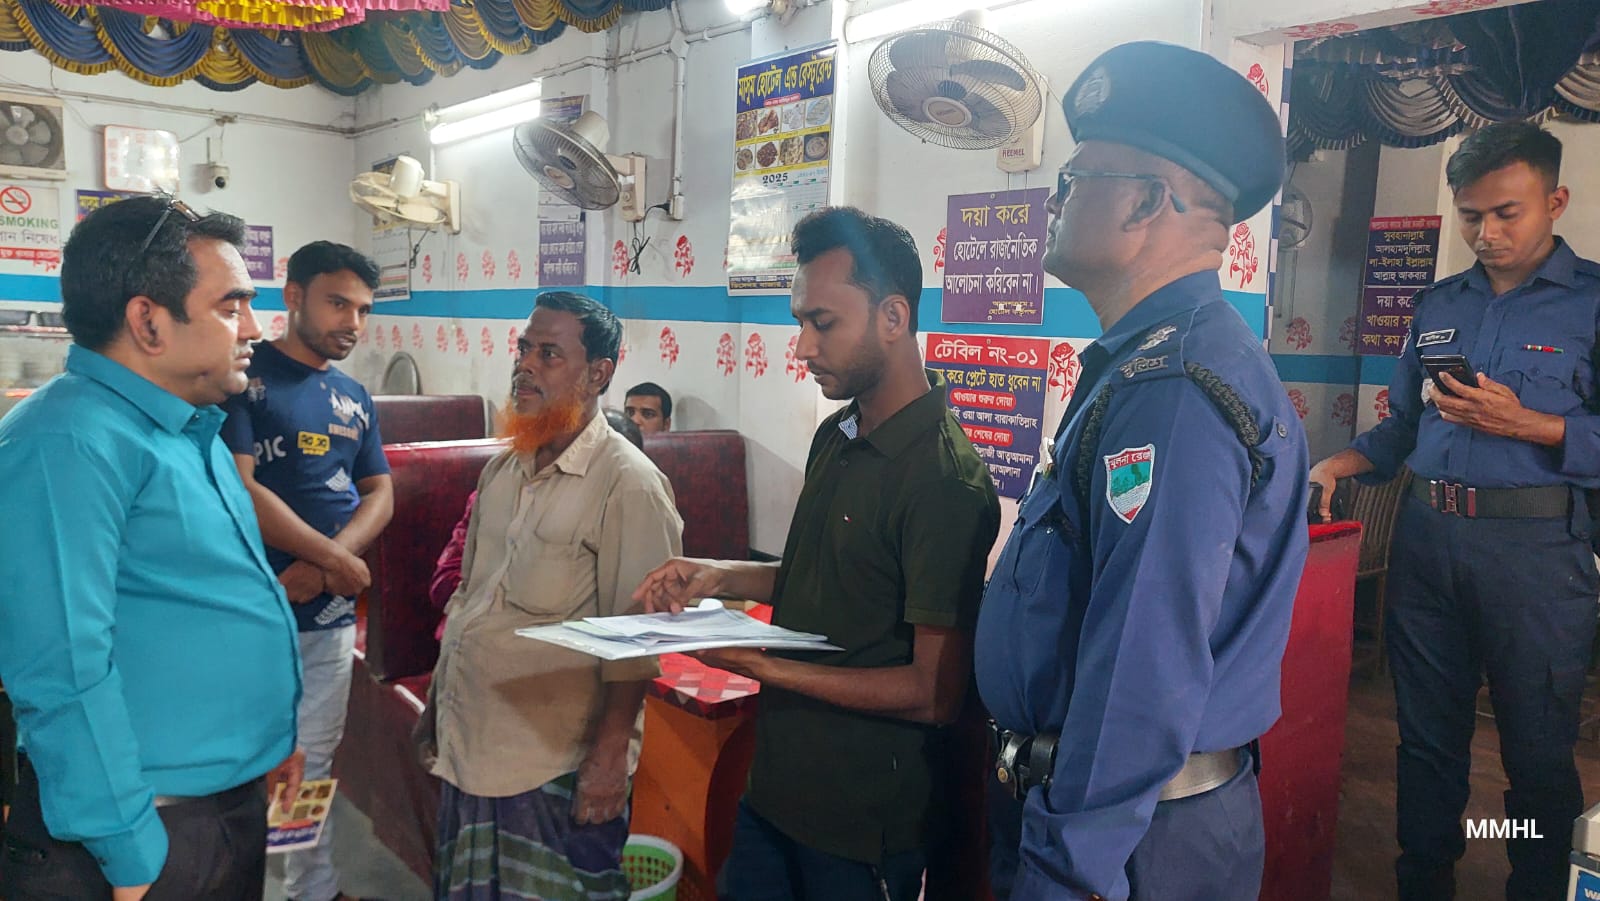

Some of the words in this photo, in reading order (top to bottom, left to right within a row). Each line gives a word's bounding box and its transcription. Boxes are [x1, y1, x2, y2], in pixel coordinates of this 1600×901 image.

[738, 75, 756, 107] মাসুম
[757, 64, 783, 99] হোটেল
[762, 173, 789, 184] 2025
[0, 216, 59, 229] SMOKING
[961, 205, 990, 228] দয়া
[994, 203, 1031, 225] করে
[953, 235, 988, 262] হোটেলে
[989, 231, 1038, 260] রাজনৈতিক
[945, 273, 983, 295] আলোচনা
[985, 267, 1020, 295] করিবেন
[1376, 295, 1394, 308] দয়া
[1366, 314, 1400, 328] খাওয়ার
[934, 338, 982, 362] টেবিল
[987, 344, 1039, 367] নং-০১
[1362, 334, 1381, 347] কথা
[1384, 335, 1400, 347] কম
[946, 369, 965, 385] করে
[965, 369, 986, 388] প্লেটে
[988, 372, 1007, 388] হাত
[1007, 373, 1029, 394] ধুবেন
[1031, 376, 1042, 393] না
